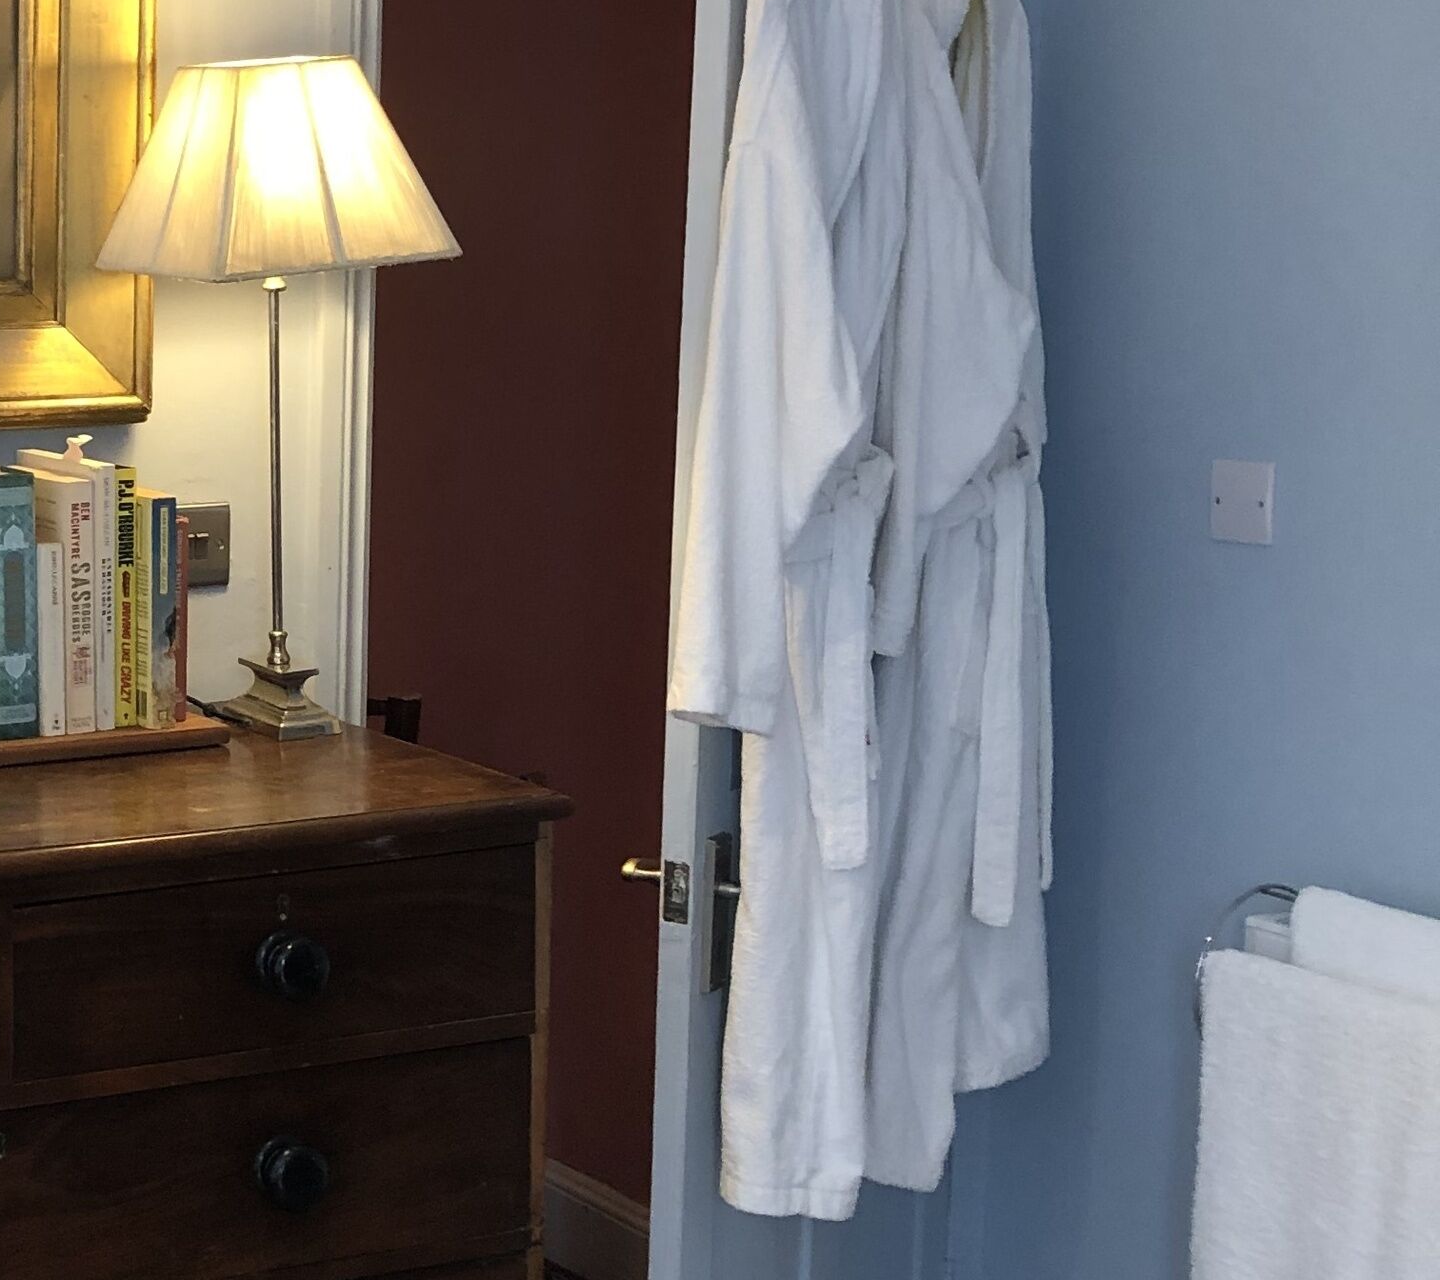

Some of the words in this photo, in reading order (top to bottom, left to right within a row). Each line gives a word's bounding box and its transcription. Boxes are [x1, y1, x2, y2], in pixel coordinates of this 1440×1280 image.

[118, 479, 135, 500] P.J.
[70, 503, 81, 560] MACINTYRE
[80, 502, 91, 522] BEN
[118, 502, 135, 568] O'ROURKE
[71, 562, 91, 603] SAS
[71, 604, 82, 644] HEROES
[81, 603, 92, 636] ROGUE
[121, 601, 132, 640] DRIVING
[121, 642, 132, 664] LIKE
[120, 665, 133, 705] CRAZY
